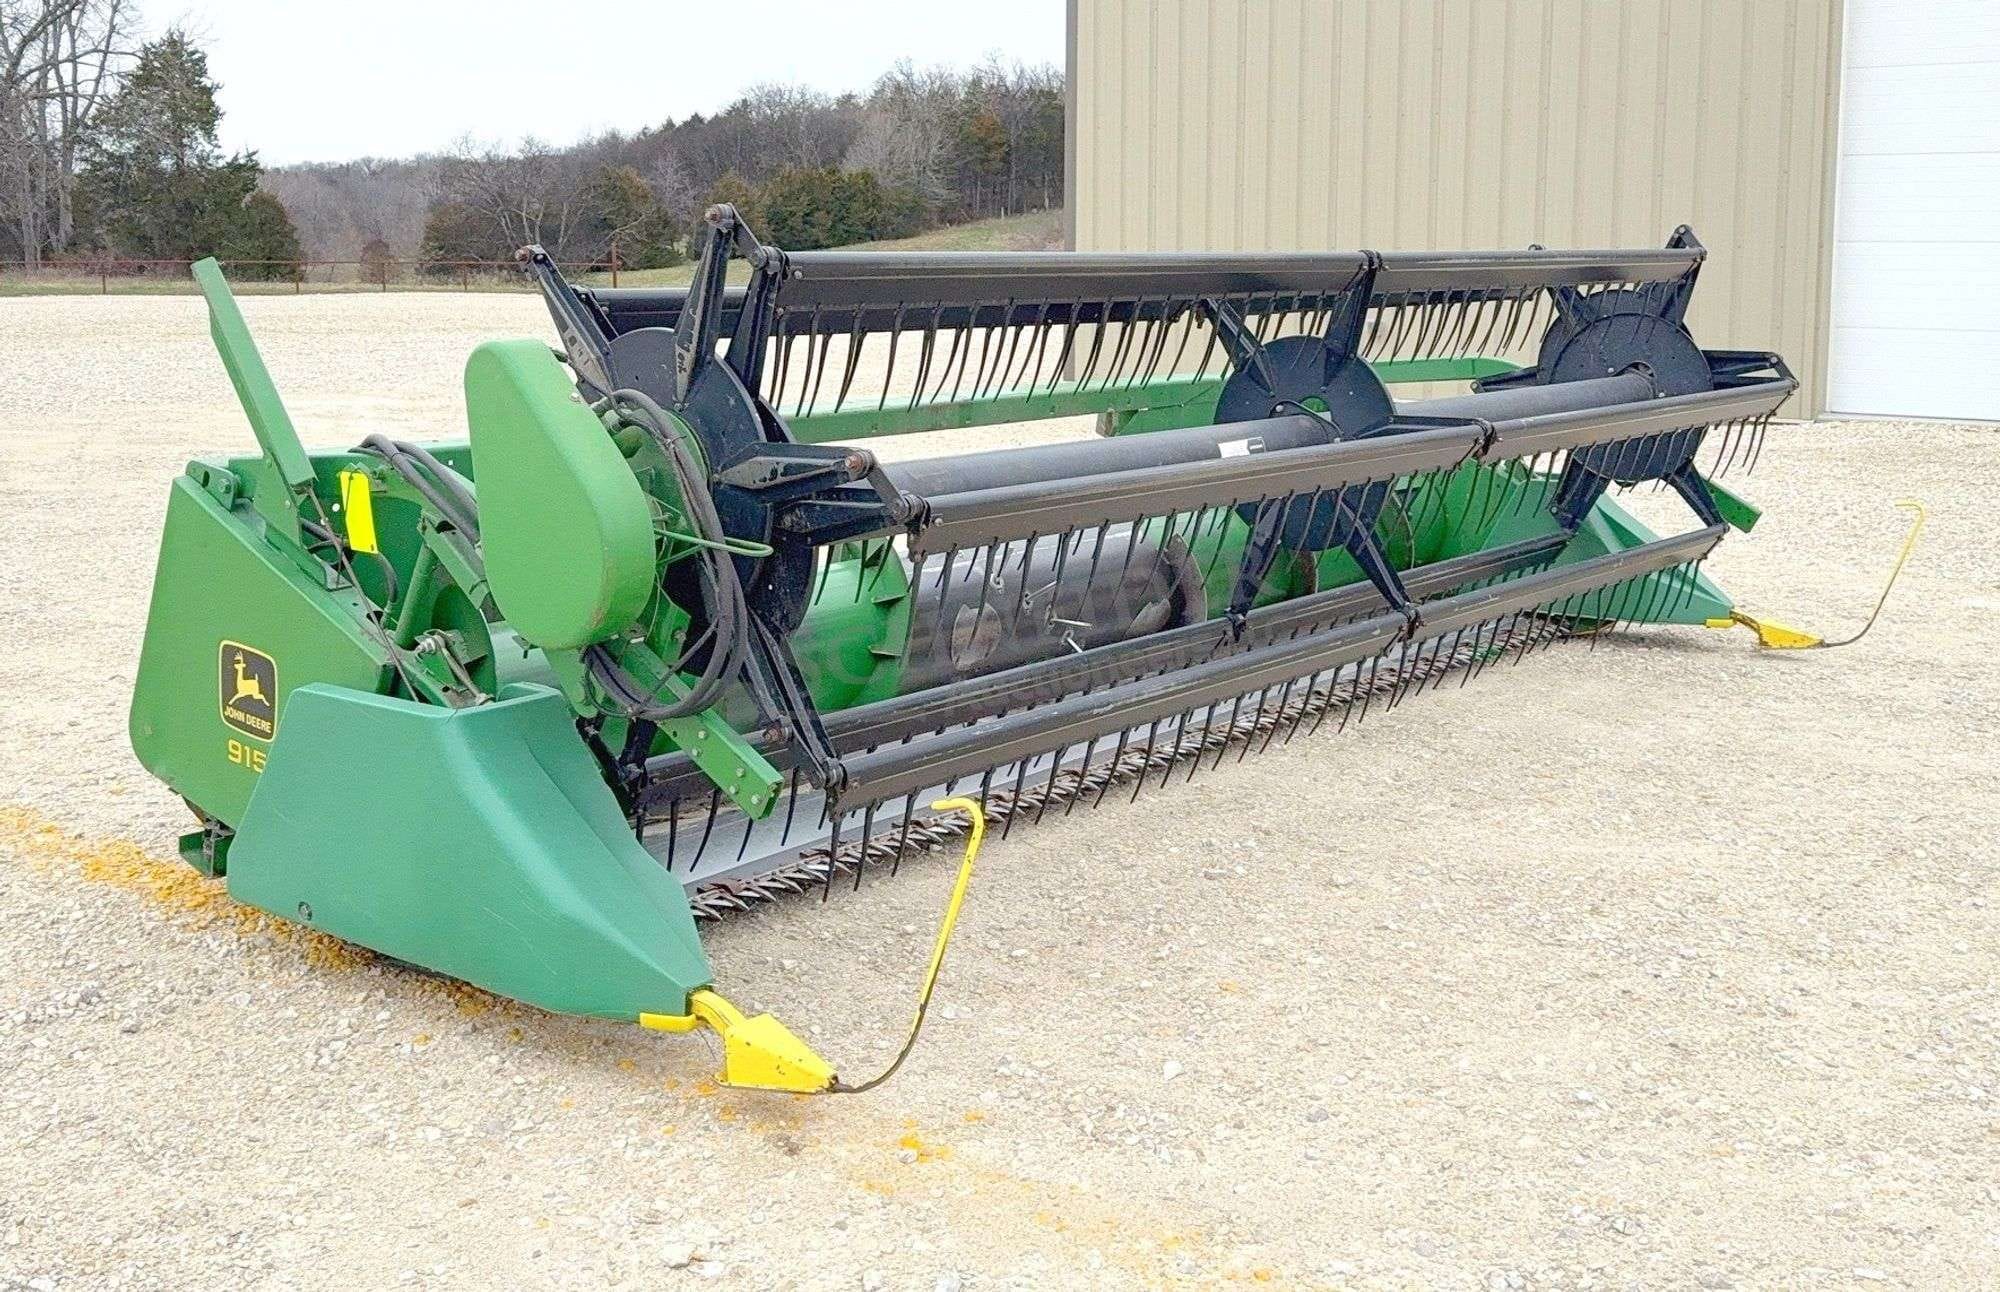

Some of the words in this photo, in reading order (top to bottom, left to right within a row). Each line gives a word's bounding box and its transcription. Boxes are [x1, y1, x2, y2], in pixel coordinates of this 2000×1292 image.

[224, 706, 245, 722] JOHN
[246, 713, 272, 734] DEERE
[228, 739, 267, 773] 915
